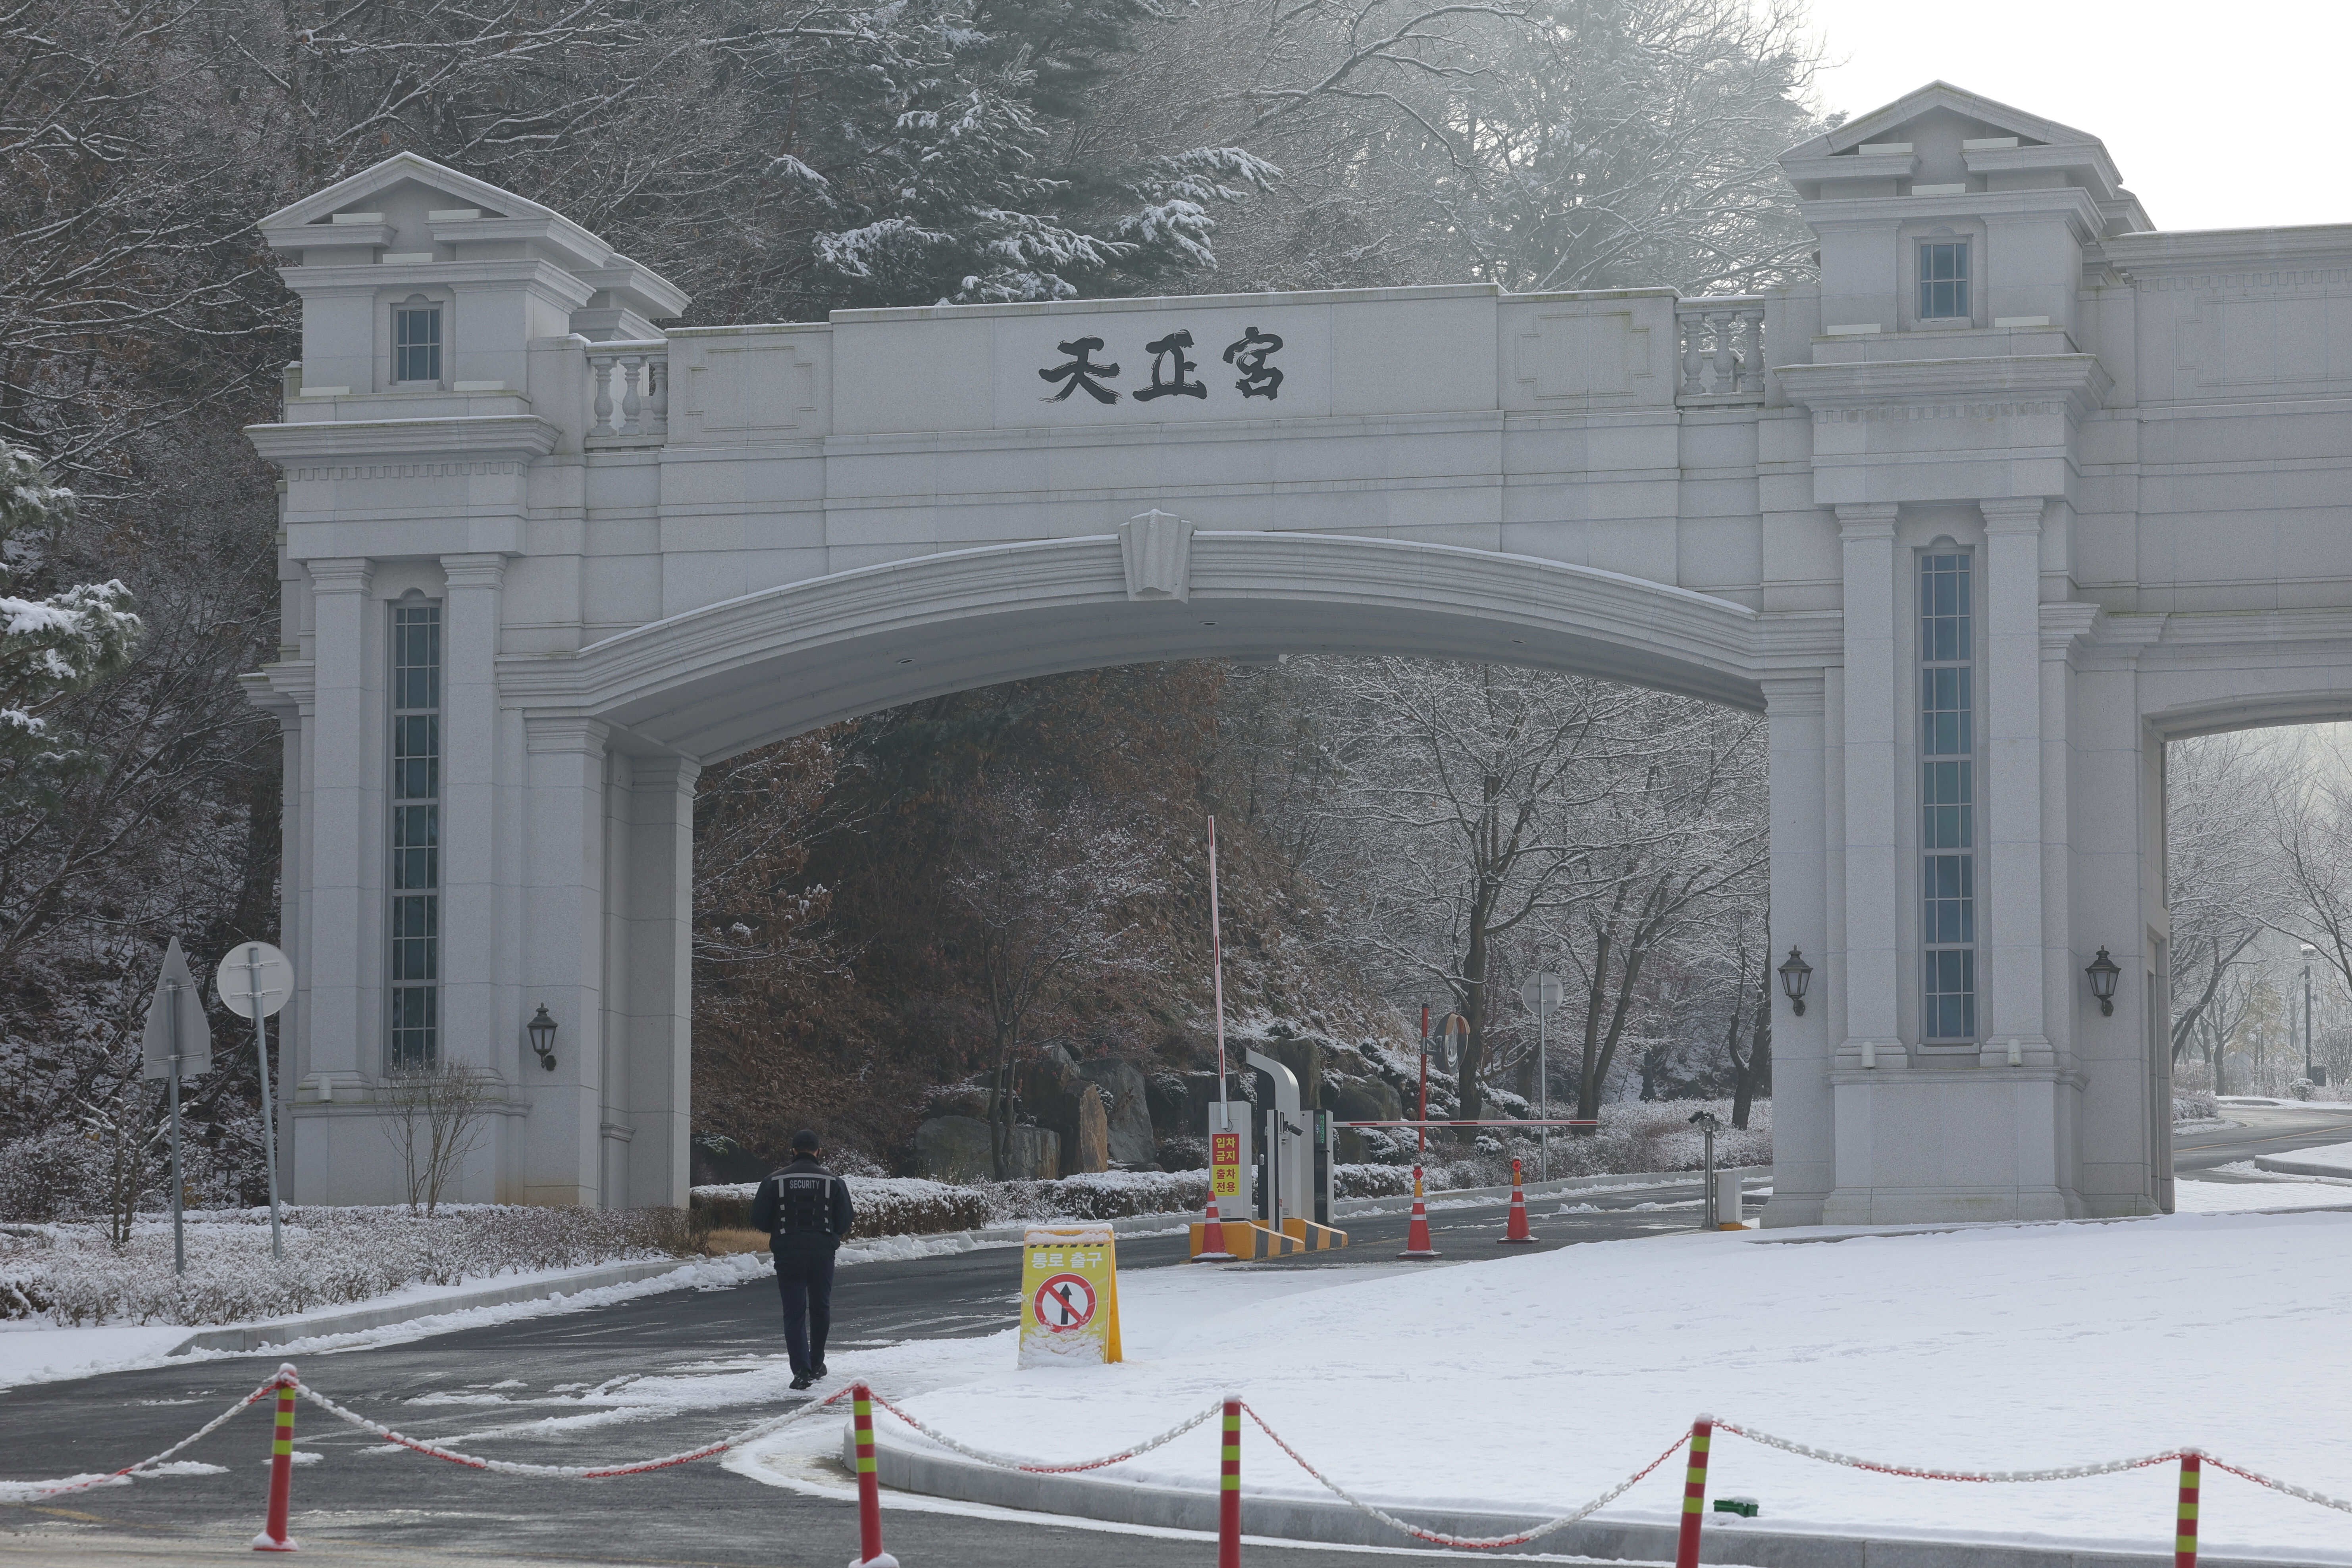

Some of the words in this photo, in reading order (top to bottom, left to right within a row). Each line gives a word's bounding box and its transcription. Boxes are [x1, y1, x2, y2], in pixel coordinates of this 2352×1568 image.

[1038, 326, 1284, 405] 天正宮
[1315, 1124, 1320, 1134] 입구
[1216, 1137, 1236, 1148] 입차
[1216, 1151, 1235, 1161] 금지
[1216, 1168, 1236, 1179] 출차
[790, 1179, 820, 1189] SECURITY
[1216, 1182, 1235, 1192] 전용
[1032, 1253, 1064, 1269] 통로
[1070, 1252, 1102, 1268] 출구
